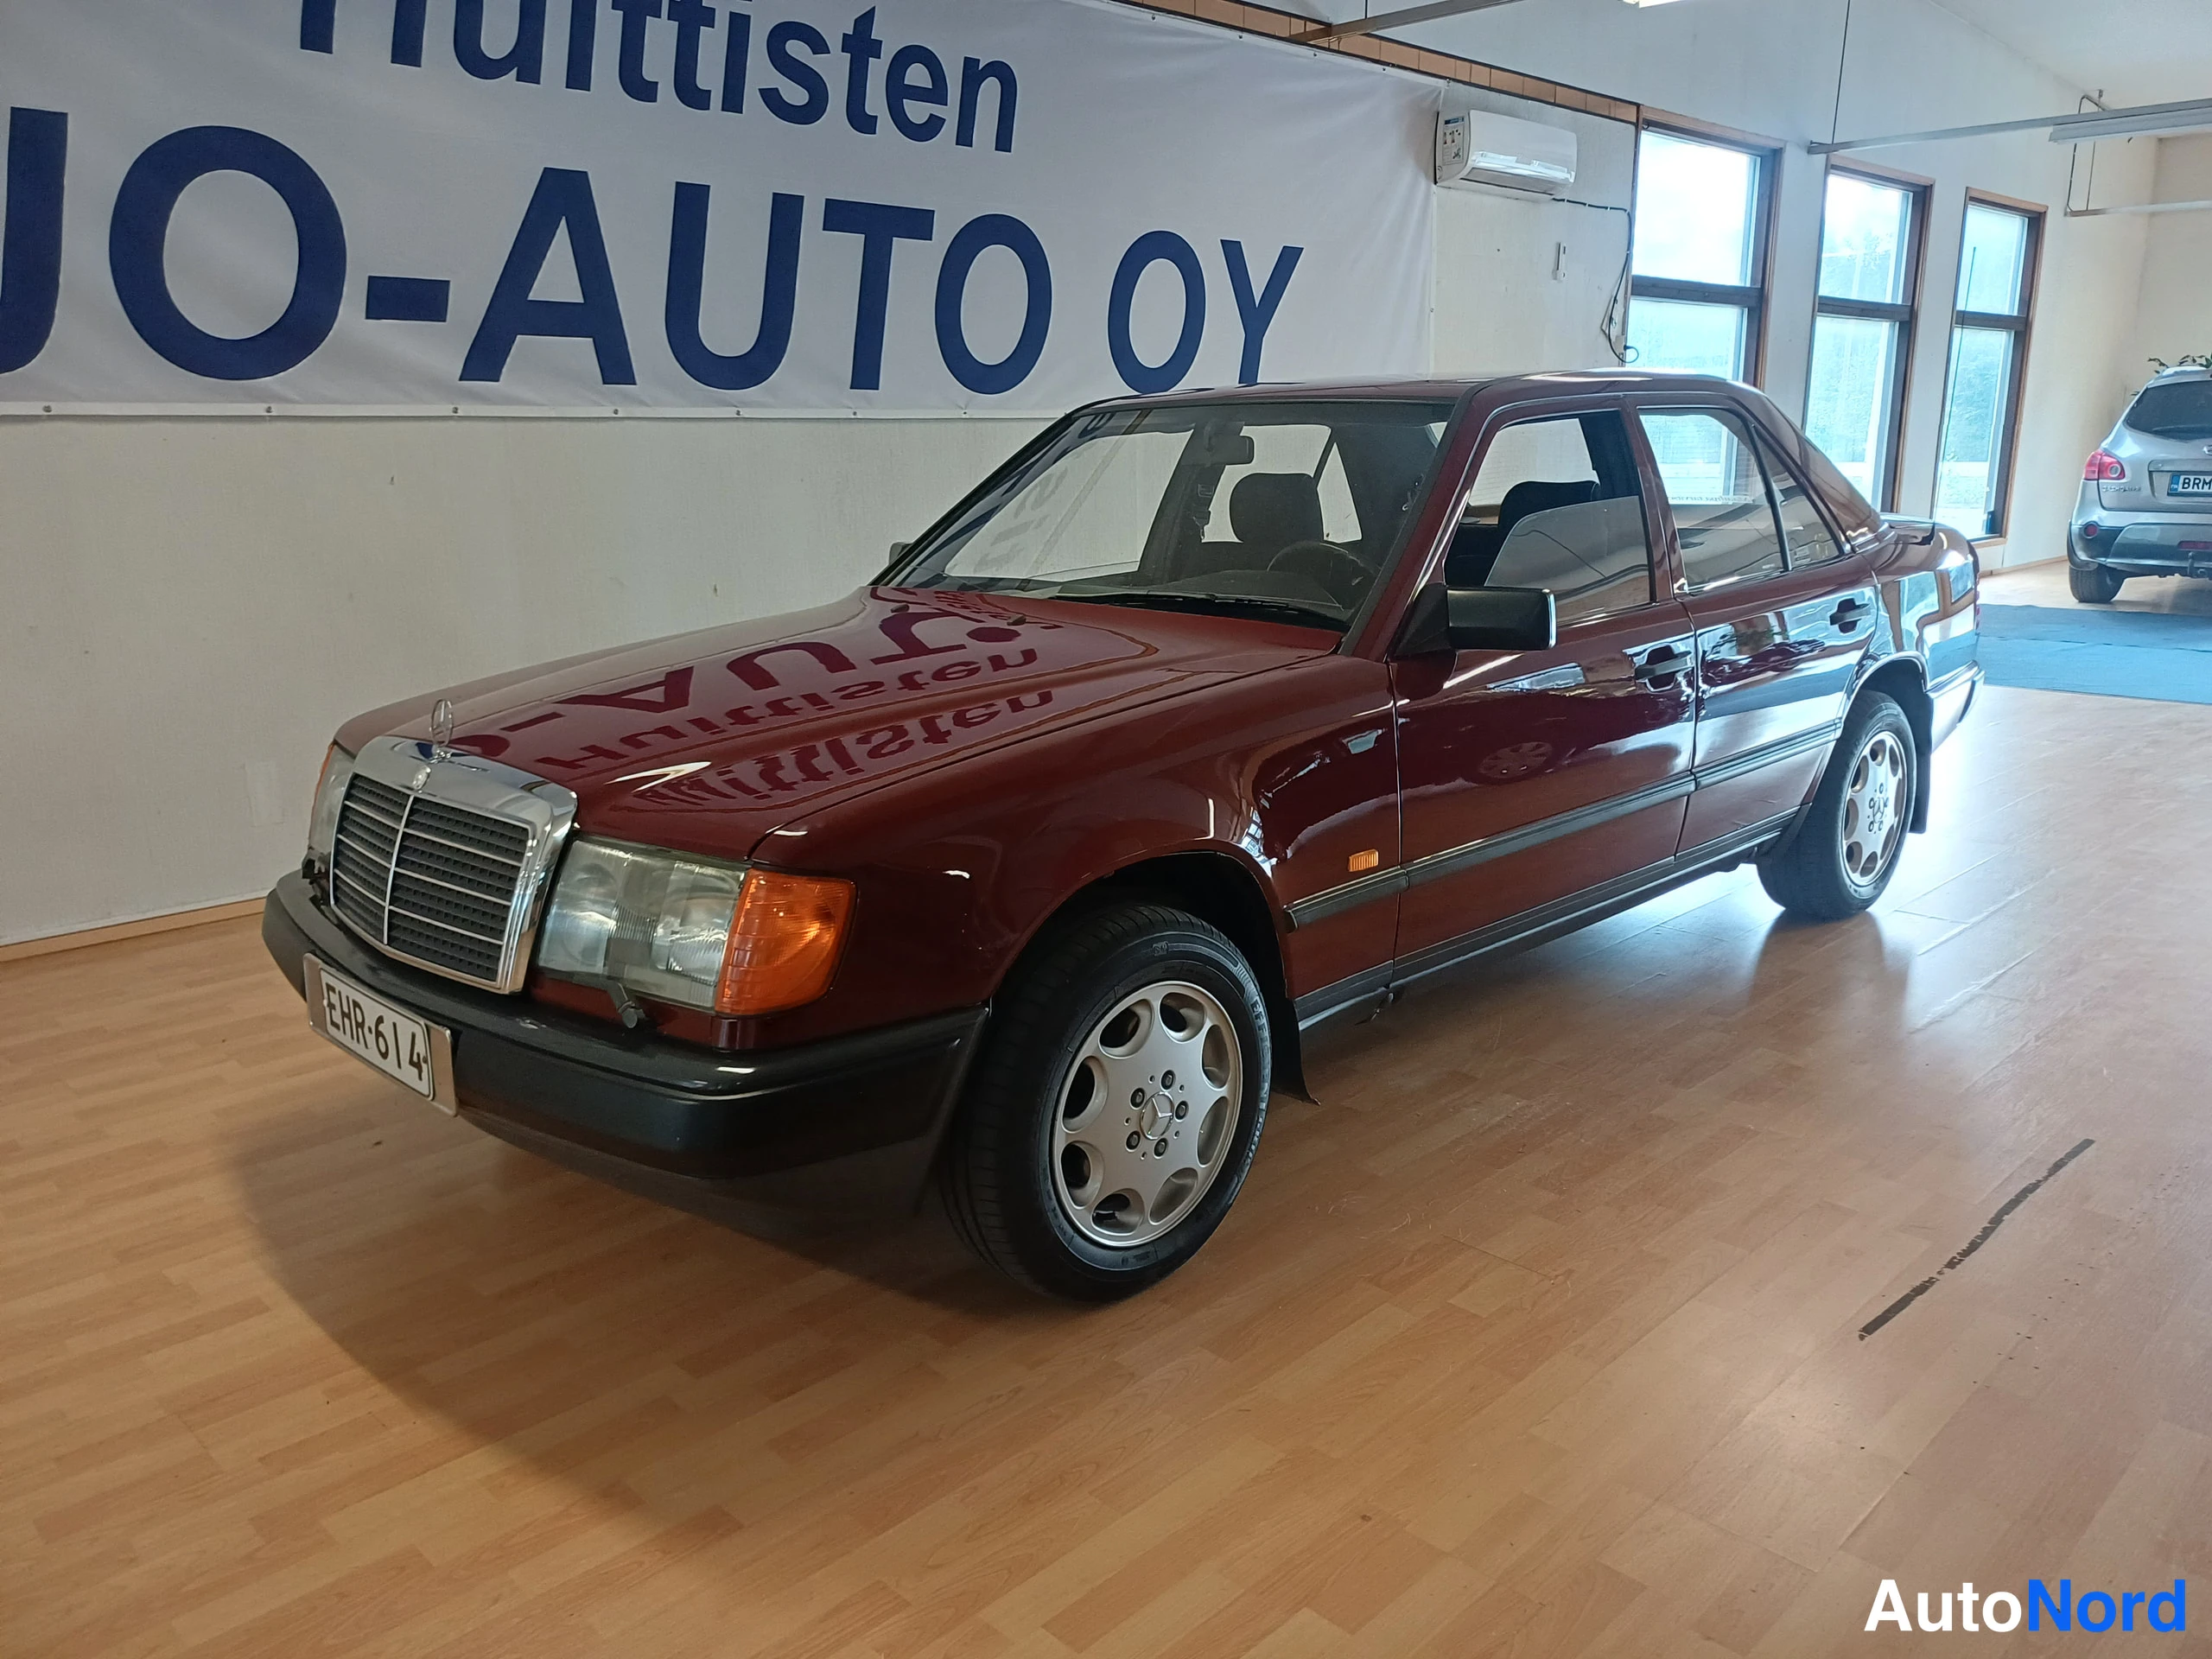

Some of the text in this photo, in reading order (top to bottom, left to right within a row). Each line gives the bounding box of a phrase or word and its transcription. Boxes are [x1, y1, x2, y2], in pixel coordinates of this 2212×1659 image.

[0, 107, 1304, 395] JO-AUTO OY
[2182, 477, 2212, 490] BRM
[325, 982, 427, 1082] EHR-614
